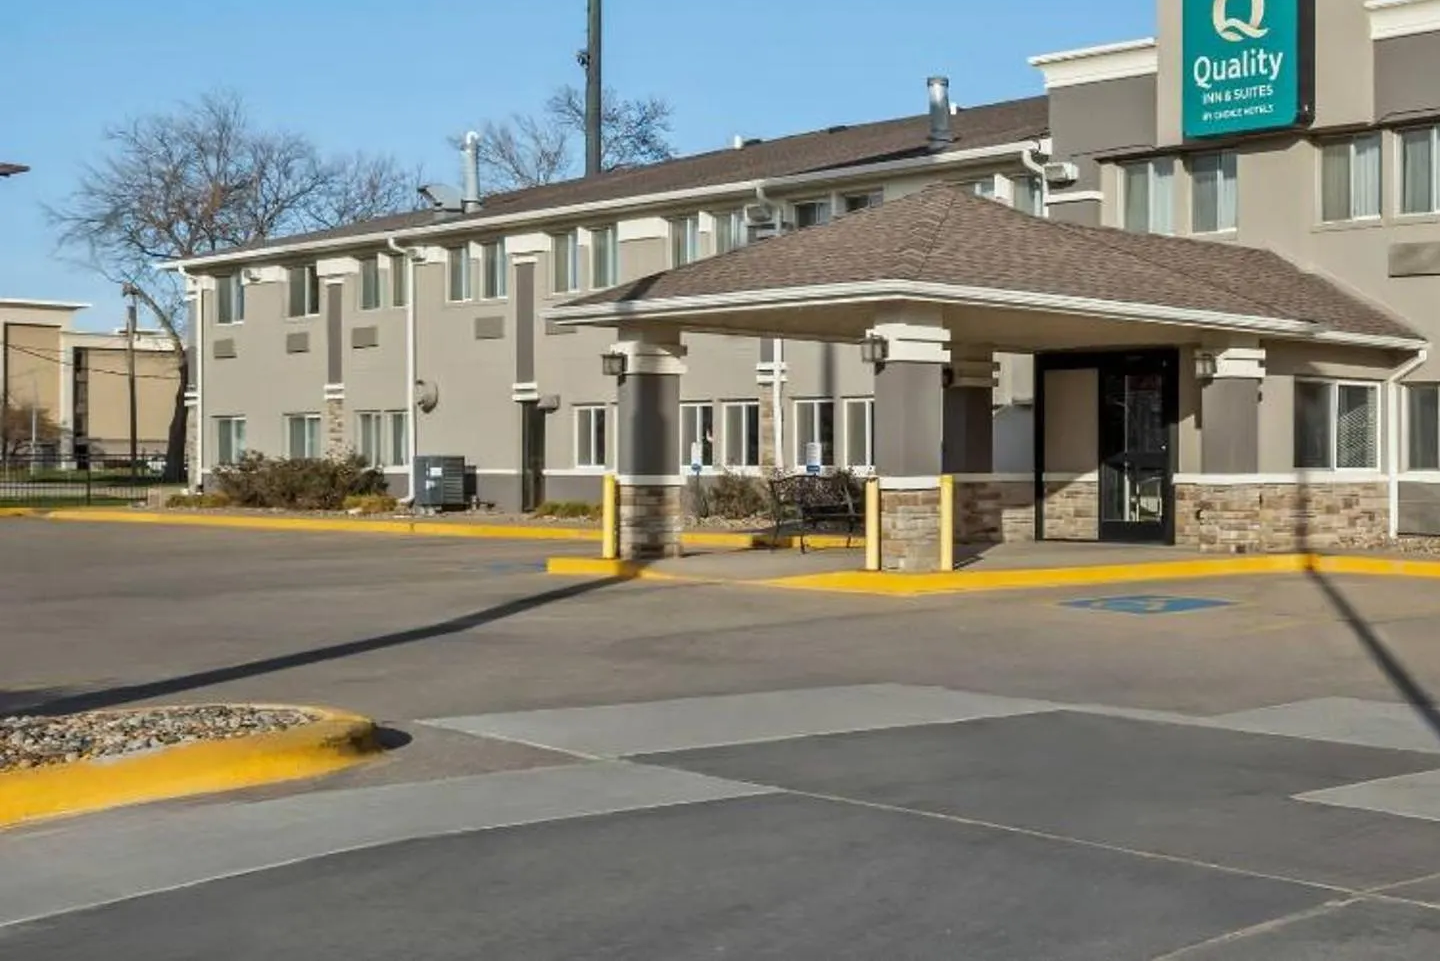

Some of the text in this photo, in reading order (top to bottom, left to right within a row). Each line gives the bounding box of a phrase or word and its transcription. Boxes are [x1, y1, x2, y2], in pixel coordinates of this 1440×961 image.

[1193, 48, 1284, 89] Quality
[1203, 84, 1274, 105] INN & SUITES
